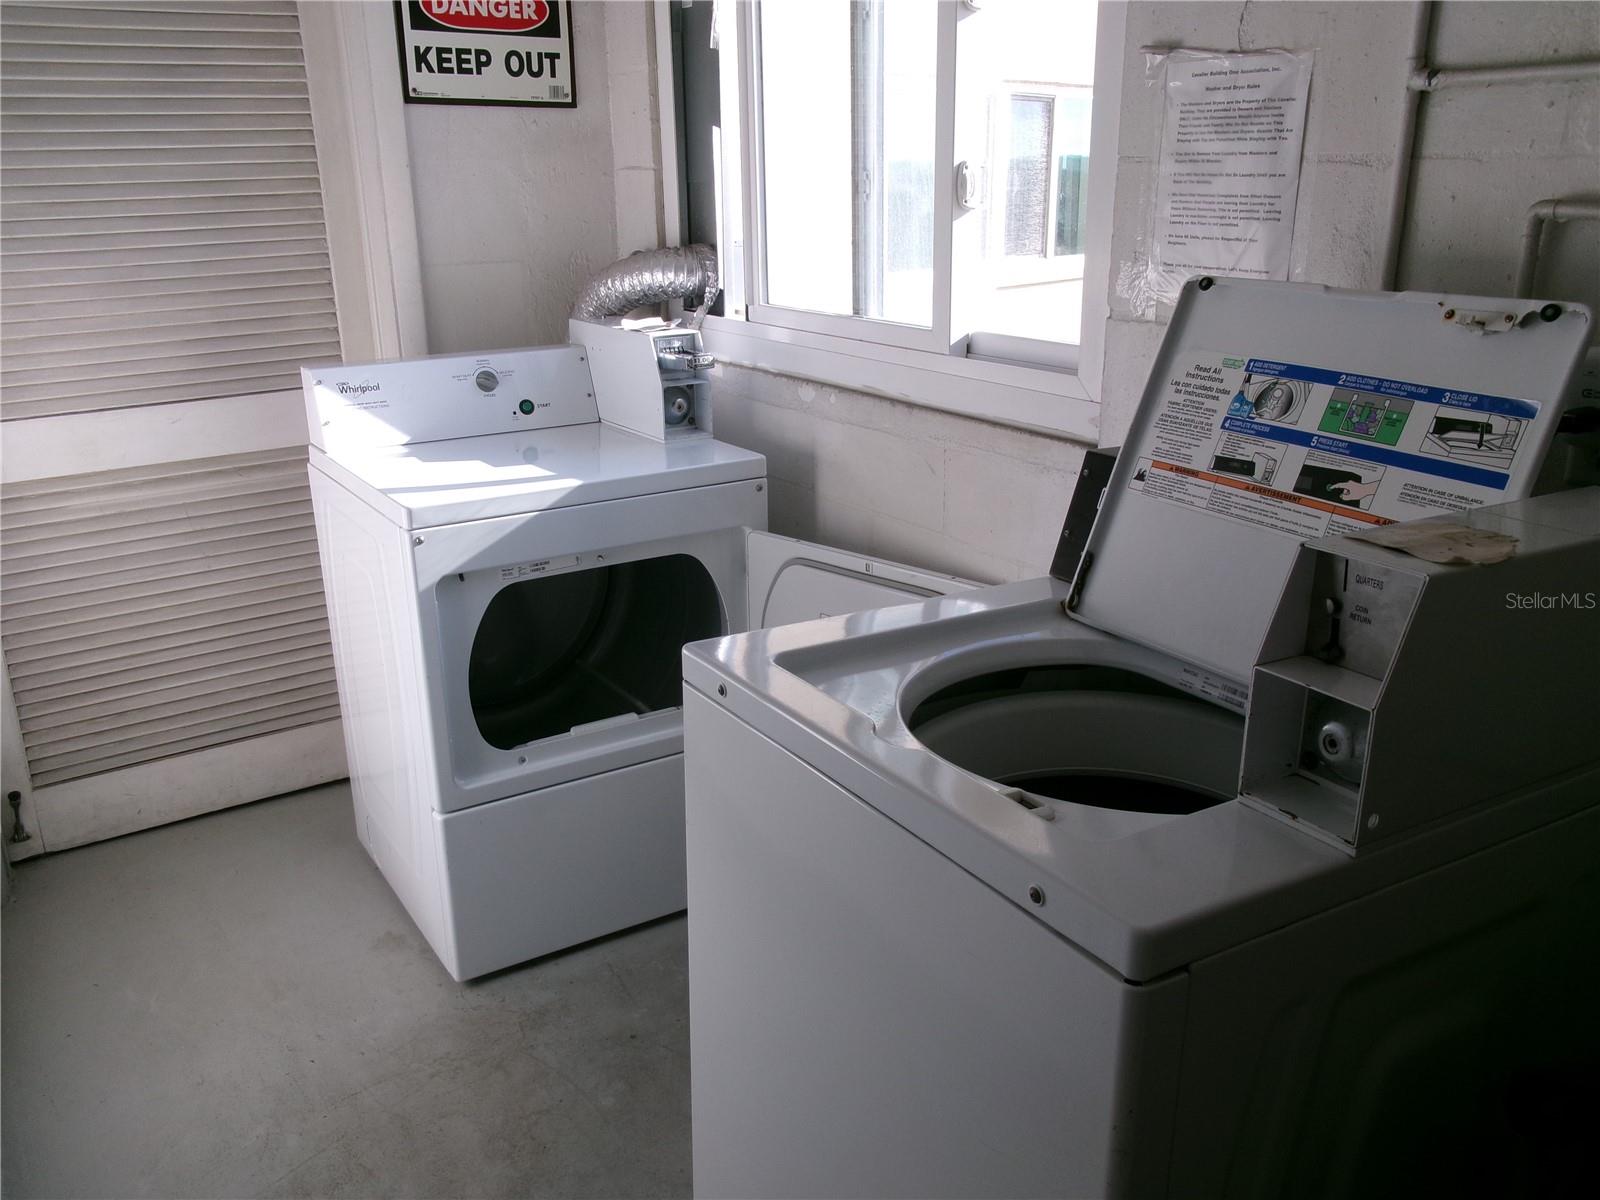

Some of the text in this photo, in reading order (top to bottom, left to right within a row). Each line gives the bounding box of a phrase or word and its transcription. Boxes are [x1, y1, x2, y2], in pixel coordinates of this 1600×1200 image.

[431, 0, 539, 20] DANGER
[413, 45, 561, 79] KEEP OUT
[1194, 364, 1222, 375] Read All
[1248, 360, 1255, 371] 1
[1185, 371, 1224, 384] Instructions
[1336, 374, 1346, 385] 2
[337, 382, 380, 394] Whirlpool
[1170, 378, 1181, 387] Lea
[1192, 383, 1215, 393] cuidado
[1215, 387, 1231, 396] todas
[1174, 386, 1183, 394] las
[1441, 392, 1479, 403] 3 CLOSE LID
[1224, 419, 1231, 429] 4
[1310, 435, 1319, 447] 5
[1332, 440, 1350, 449] START
[1250, 485, 1302, 505] AVERTISSEMENT
[1355, 574, 1384, 591] QUARTERS
[1355, 604, 1369, 614] COIN
[1349, 611, 1372, 625] RETURN
